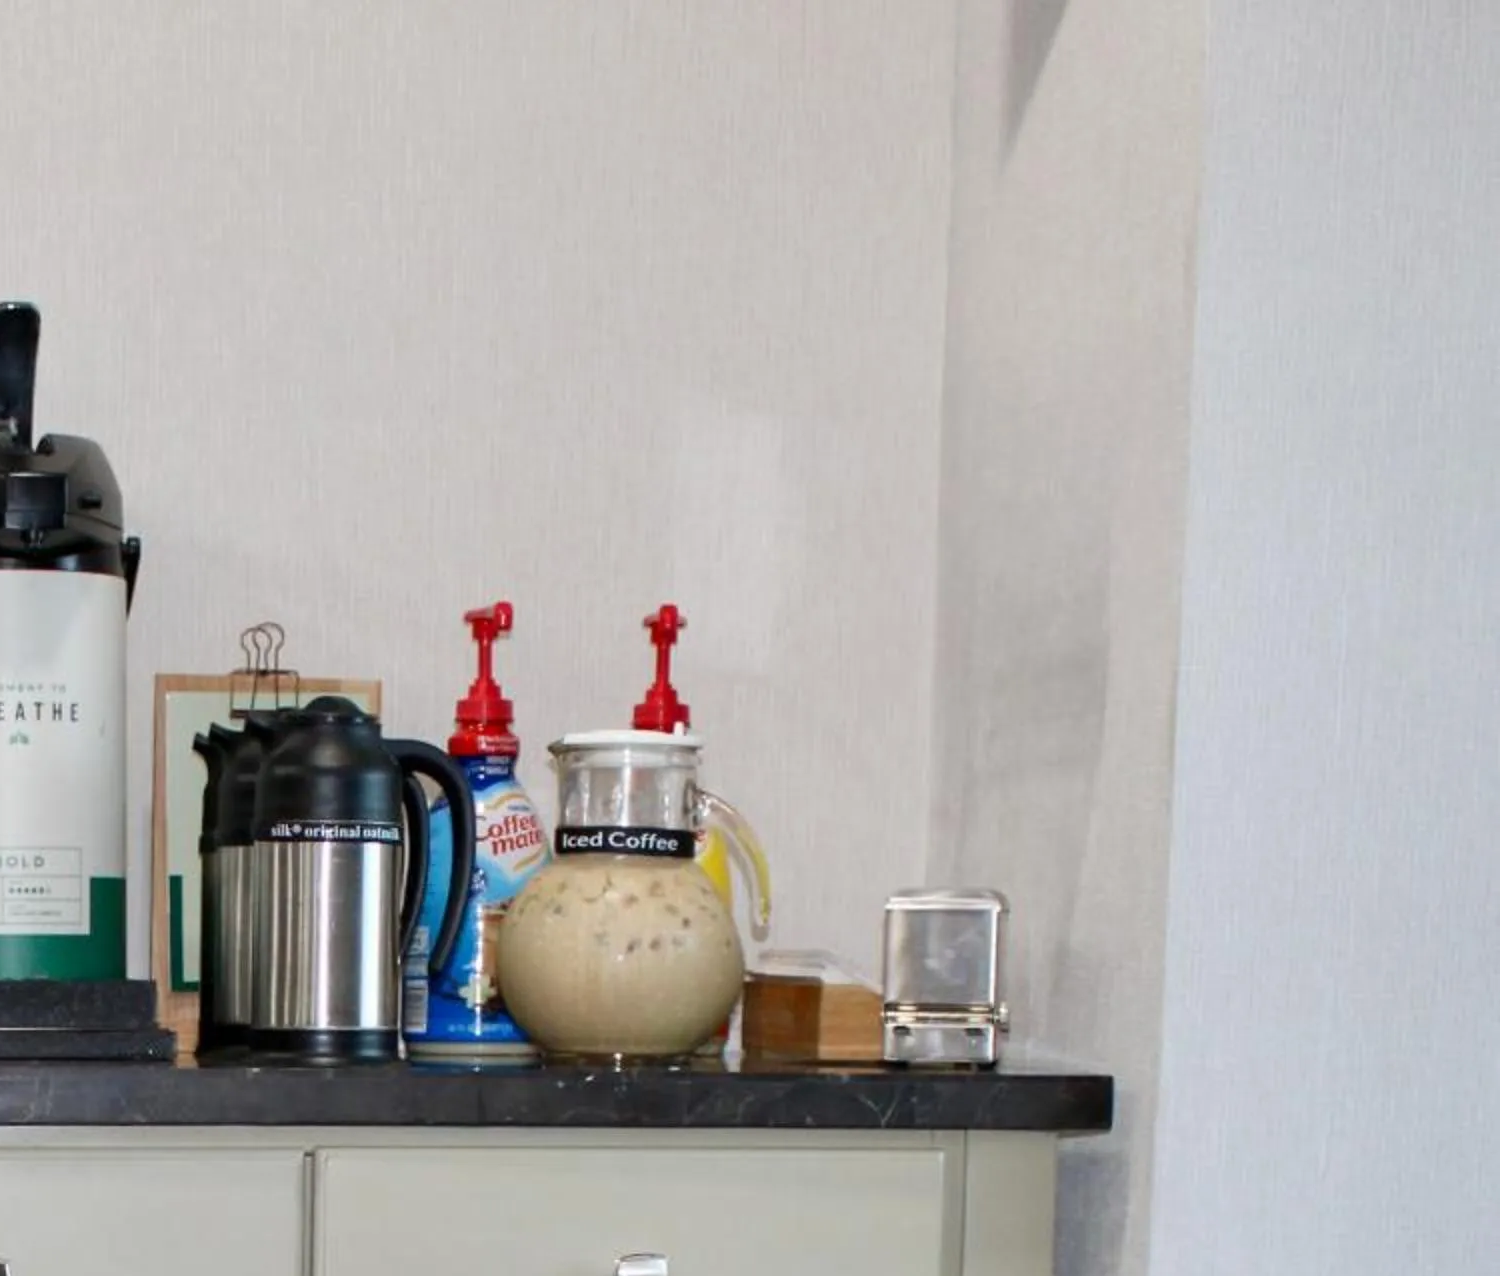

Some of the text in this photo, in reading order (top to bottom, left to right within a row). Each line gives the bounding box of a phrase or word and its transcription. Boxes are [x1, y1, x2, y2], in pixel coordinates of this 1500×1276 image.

[304, 824, 360, 840] original
[562, 831, 603, 849] Iced
[607, 831, 679, 851] Coffee
[491, 829, 543, 856] mate
